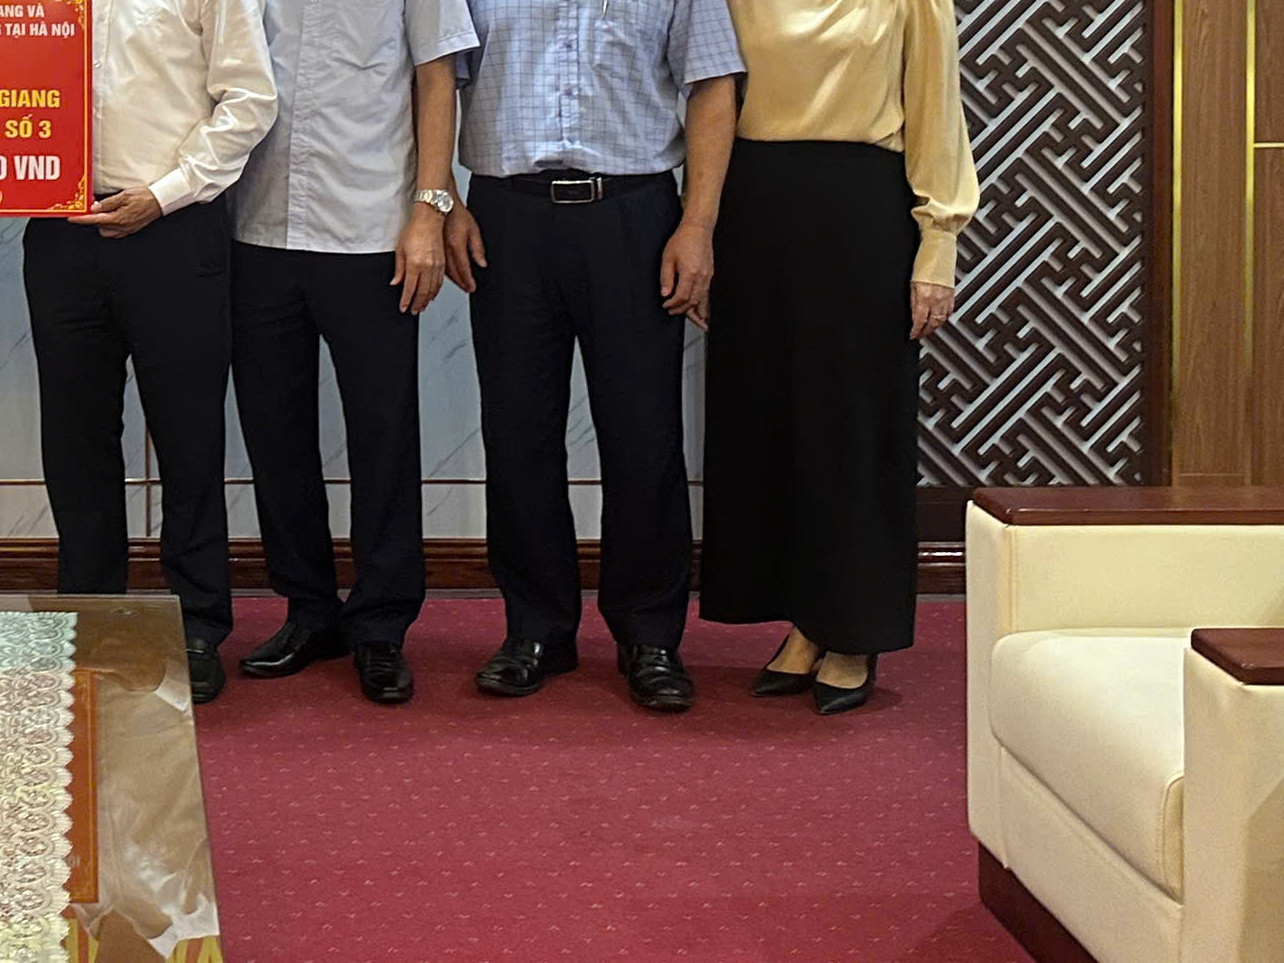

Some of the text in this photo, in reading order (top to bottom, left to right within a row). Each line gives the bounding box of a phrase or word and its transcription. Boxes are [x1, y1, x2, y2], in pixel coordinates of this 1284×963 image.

[27, 3, 45, 18] VÀ
[5, 23, 26, 38] TẠI
[29, 21, 48, 36] HÀ
[51, 21, 75, 39] NỘI
[5, 114, 33, 138] SỐ
[38, 120, 51, 138] 3
[13, 155, 60, 180] VND
